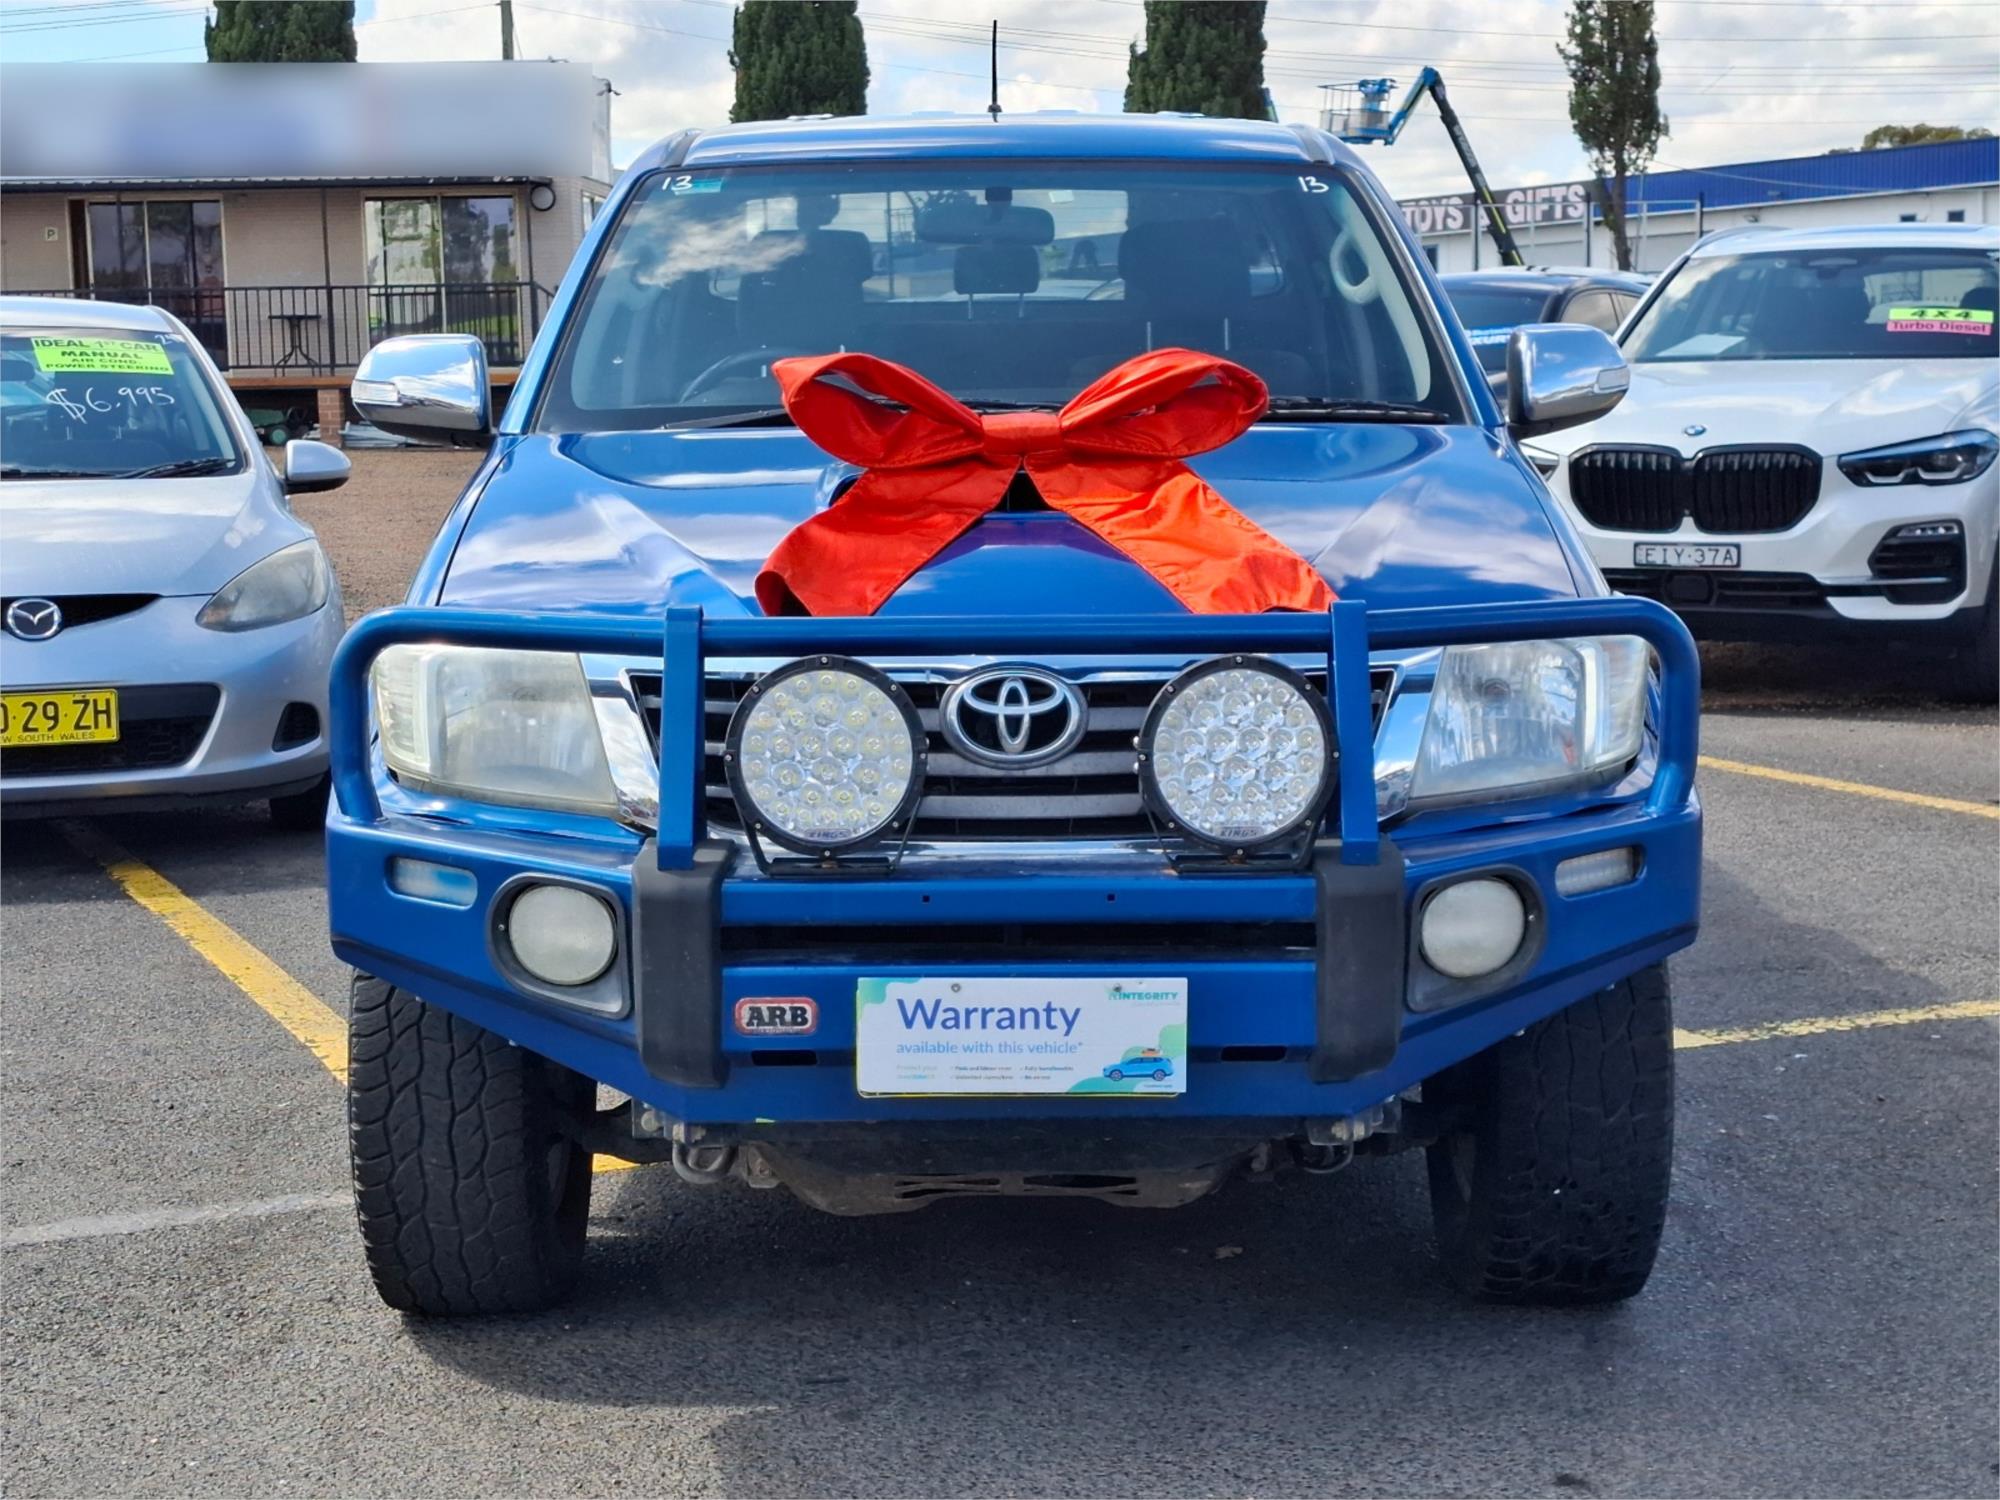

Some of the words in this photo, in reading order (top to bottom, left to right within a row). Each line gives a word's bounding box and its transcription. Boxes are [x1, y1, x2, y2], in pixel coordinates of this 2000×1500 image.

[662, 175, 692, 191] 13
[1298, 176, 1329, 193] 13
[1401, 197, 1464, 232] TOYS
[1504, 184, 1586, 224] GIFTS
[1893, 320, 1934, 331] Turbo
[1940, 321, 1986, 333] Diesel
[34, 338, 91, 349] IDEAL
[120, 341, 160, 353] CAR
[61, 350, 143, 360] MANUAL
[100, 364, 170, 372] STEERING
[17, 733, 54, 743] SOUTH
[60, 731, 96, 741] WALES
[1119, 991, 1179, 1001] INTEGRITY
[746, 1005, 809, 1027] ARB
[896, 998, 1082, 1037] Warranty
[896, 1042, 958, 1055] available
[962, 1042, 994, 1055] with
[998, 1041, 1024, 1055] this
